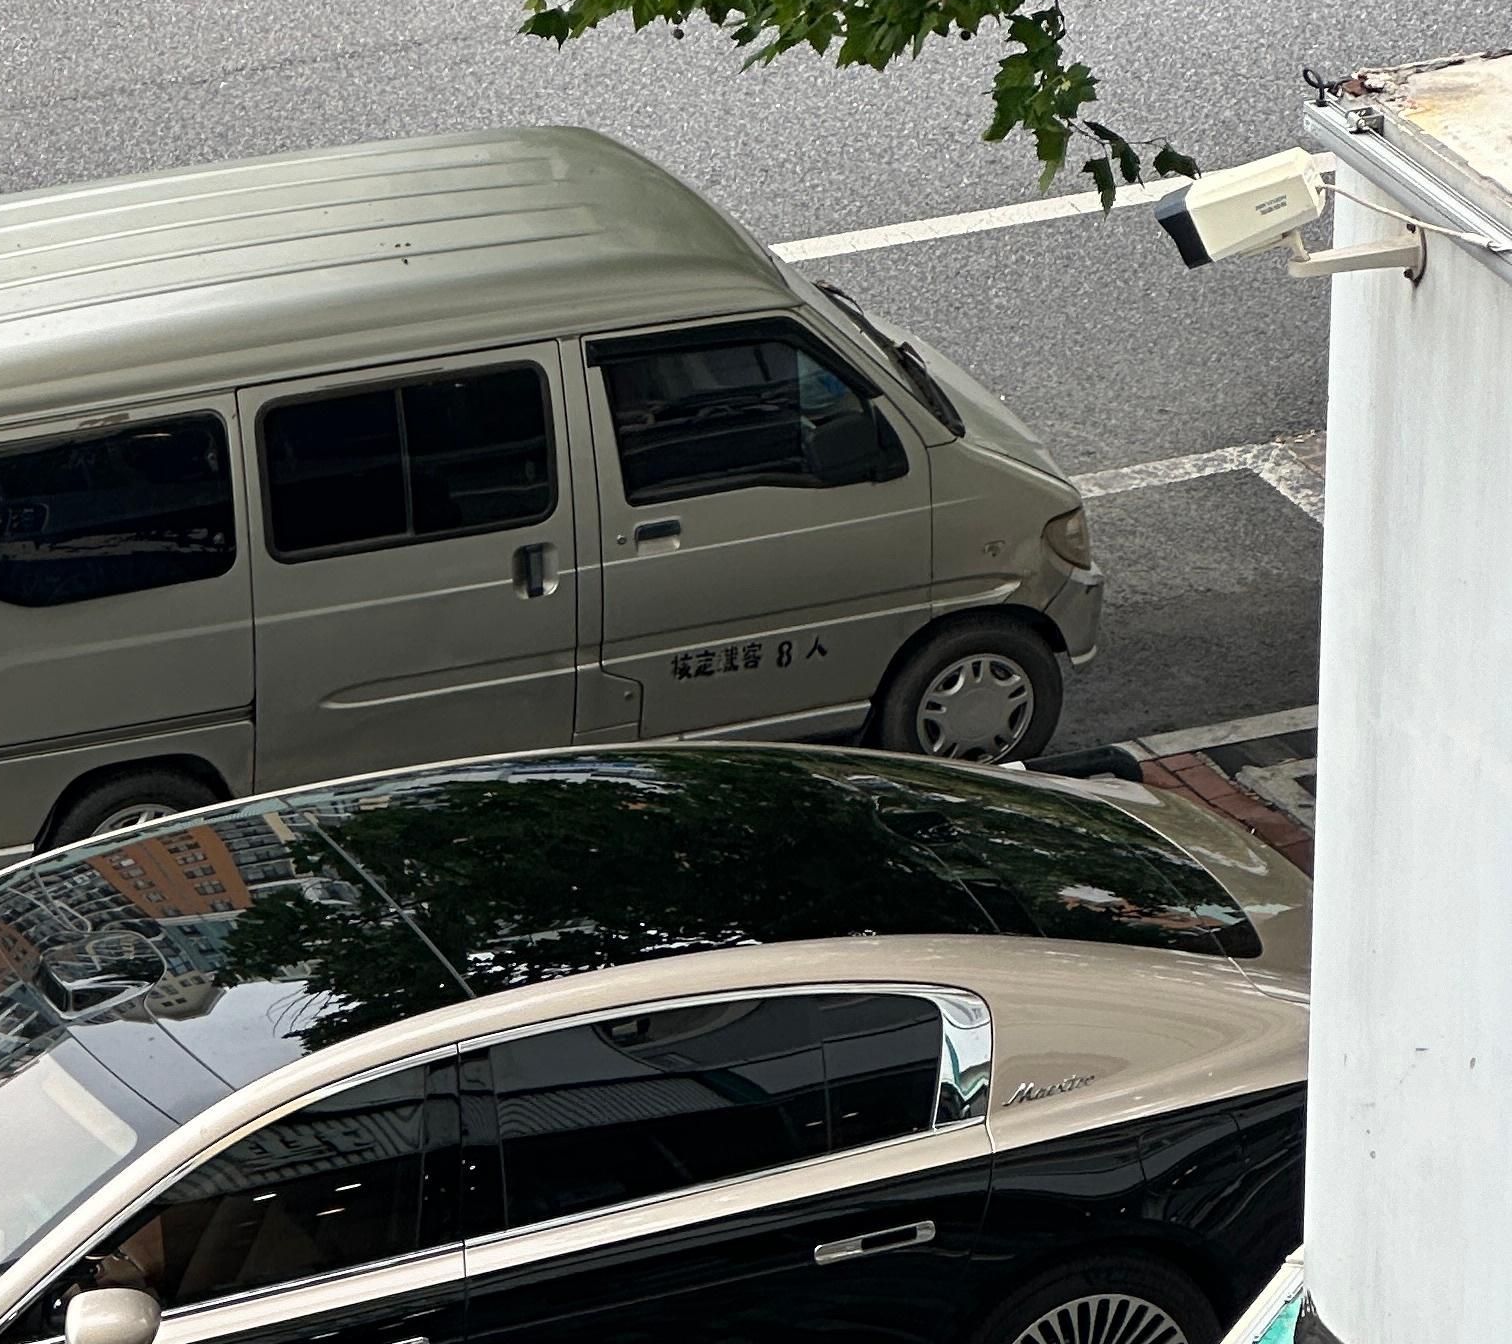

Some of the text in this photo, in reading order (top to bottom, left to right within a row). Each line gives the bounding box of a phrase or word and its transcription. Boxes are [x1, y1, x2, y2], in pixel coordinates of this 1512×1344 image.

[671, 635, 827, 680] 核定载客 8 人
